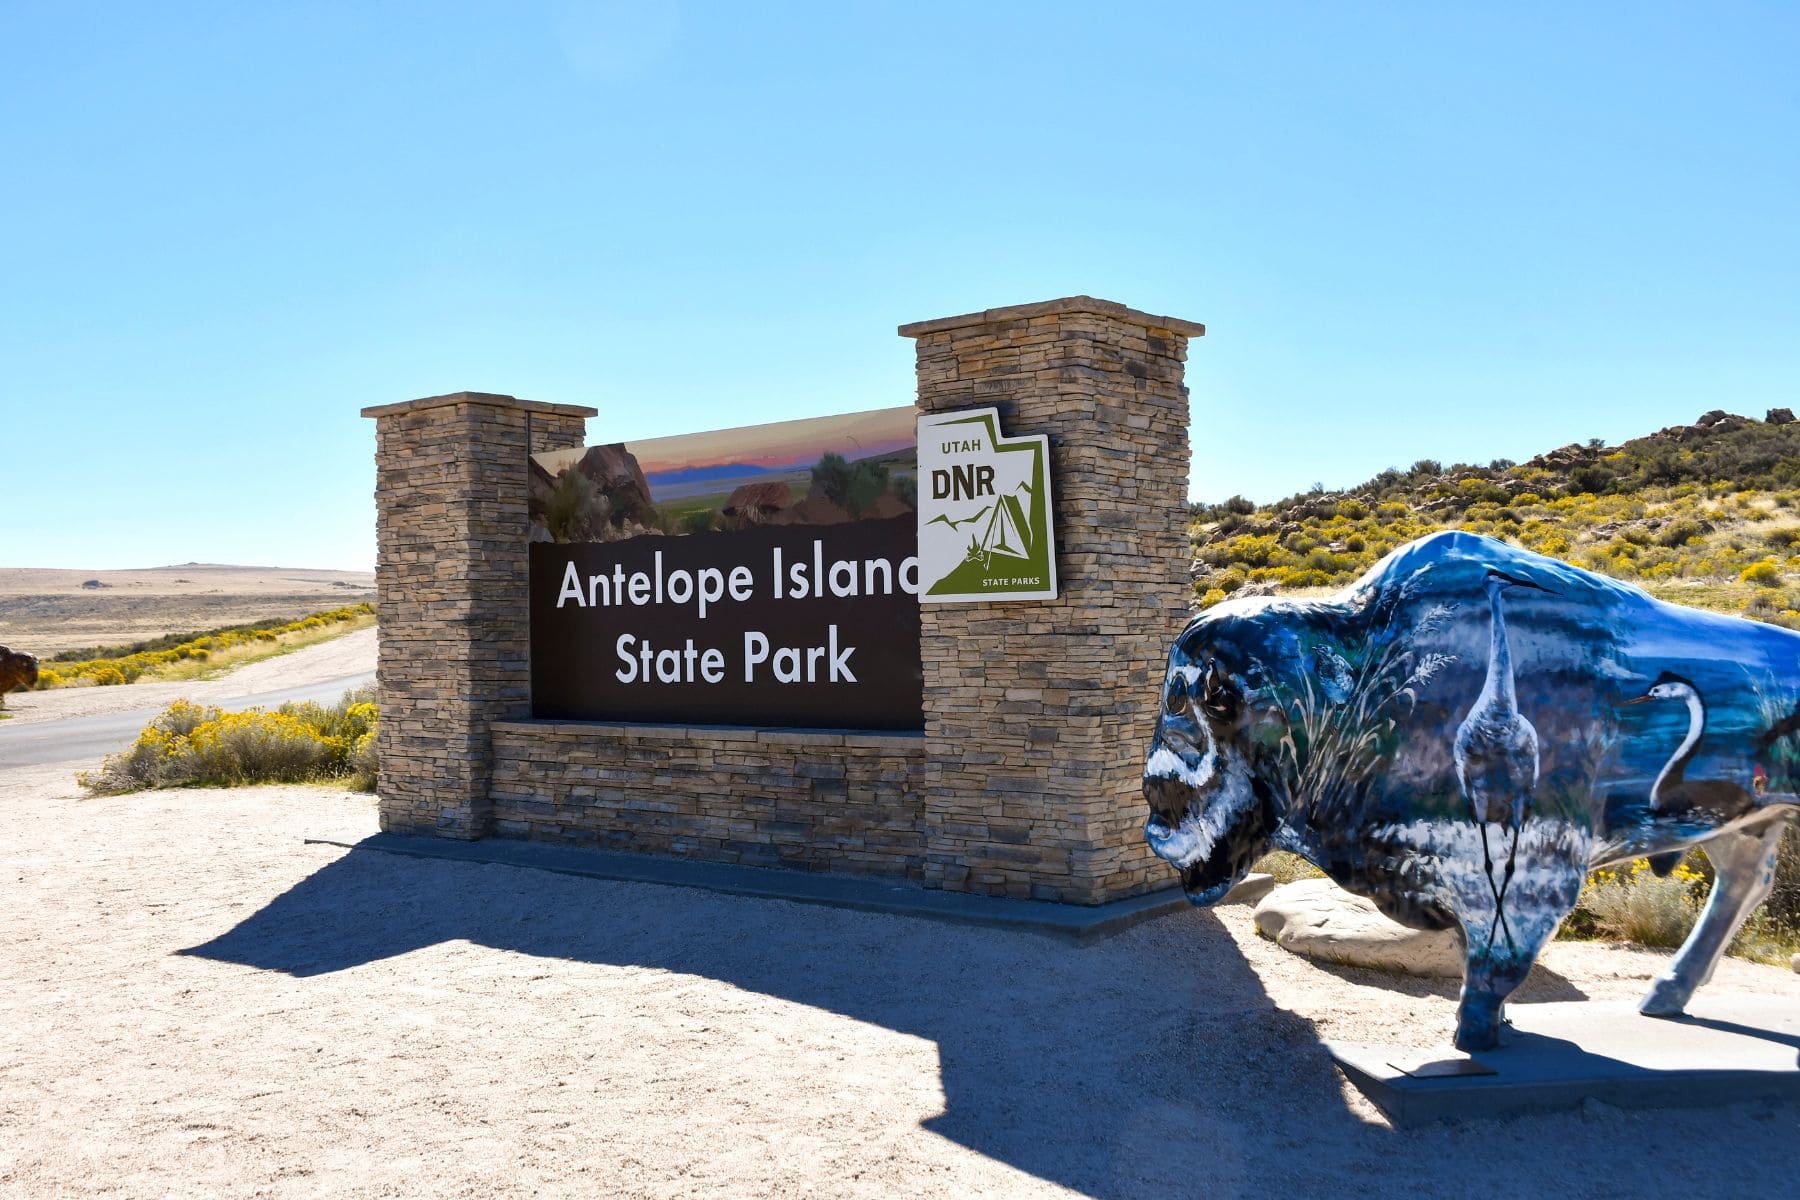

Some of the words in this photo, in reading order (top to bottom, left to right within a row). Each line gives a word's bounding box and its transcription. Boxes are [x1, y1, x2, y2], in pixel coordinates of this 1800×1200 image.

[941, 439, 981, 454] UTAH
[932, 463, 995, 501] DNR
[556, 551, 754, 619] Antelope
[982, 578, 1009, 587] STATE
[1011, 576, 1040, 586] PARKS
[615, 633, 726, 684] State
[744, 624, 858, 683] Park
